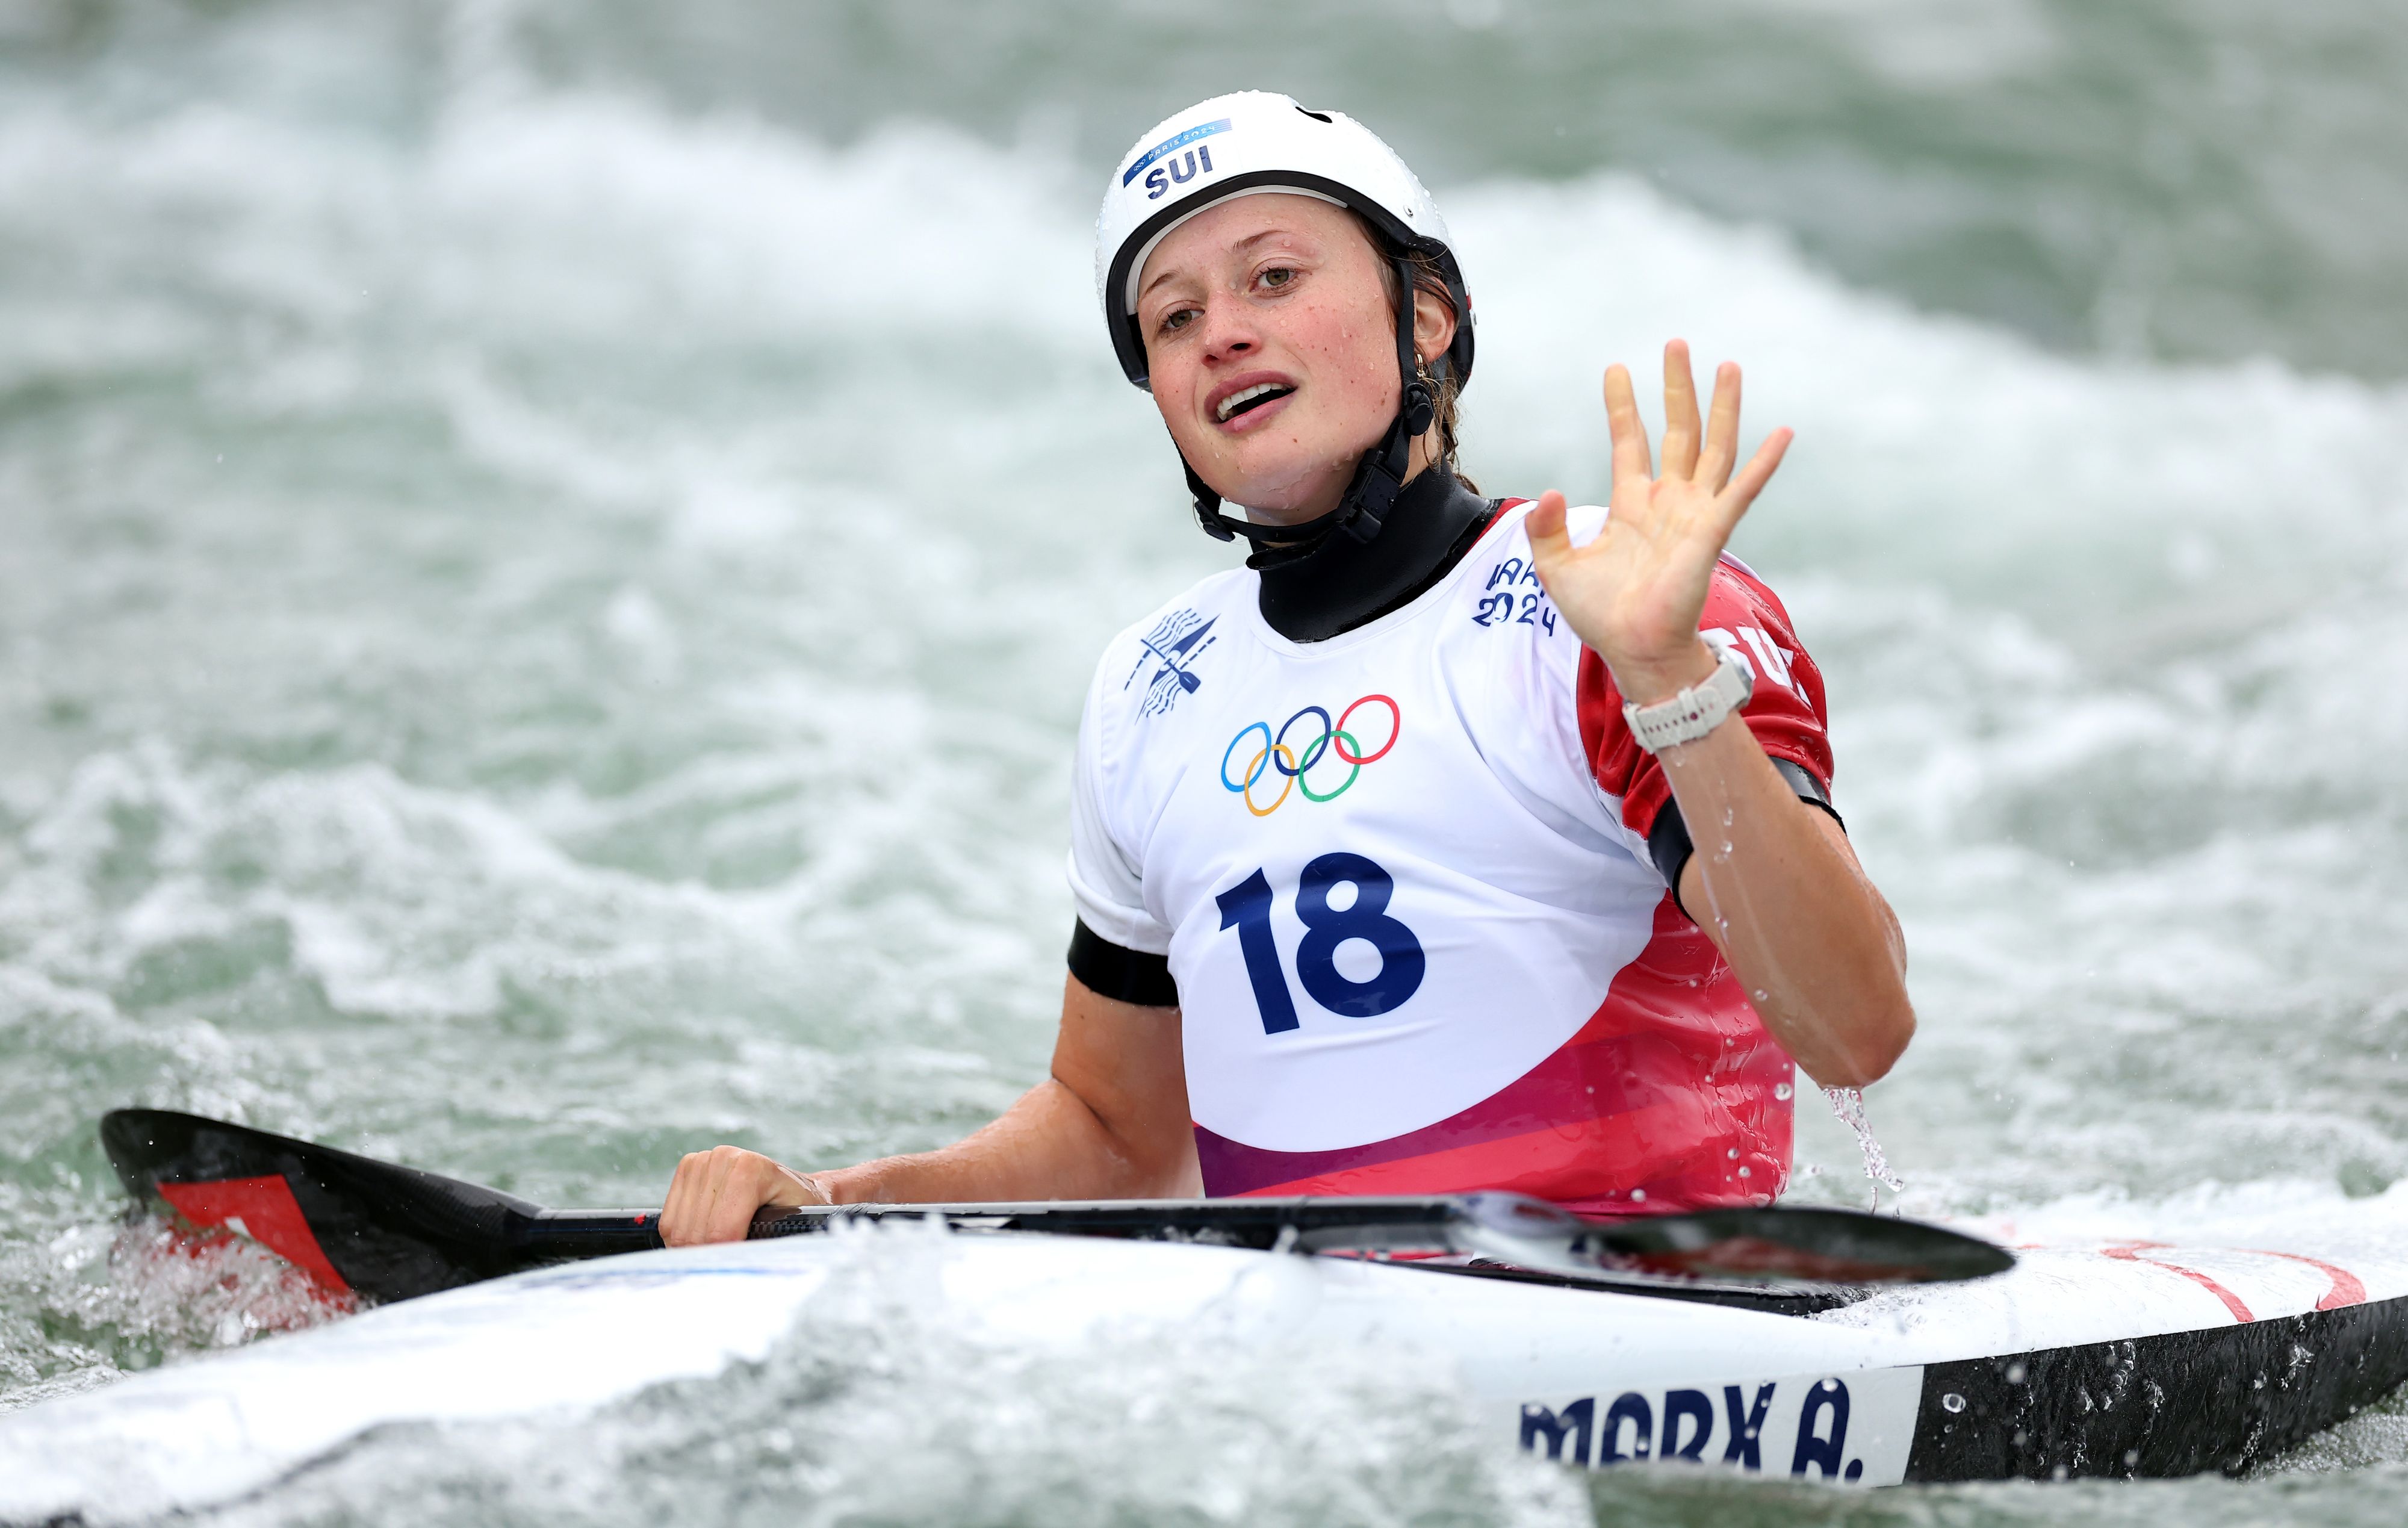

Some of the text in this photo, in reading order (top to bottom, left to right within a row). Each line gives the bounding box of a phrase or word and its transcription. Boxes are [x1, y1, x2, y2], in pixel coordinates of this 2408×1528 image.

[1147, 125, 1216, 161] PARIS 2024
[1144, 144, 1214, 200] SUI
[1471, 592, 1557, 638] 2024
[1215, 852, 1426, 1036] 18
[1519, 1377, 1864, 1485] MARX A.
